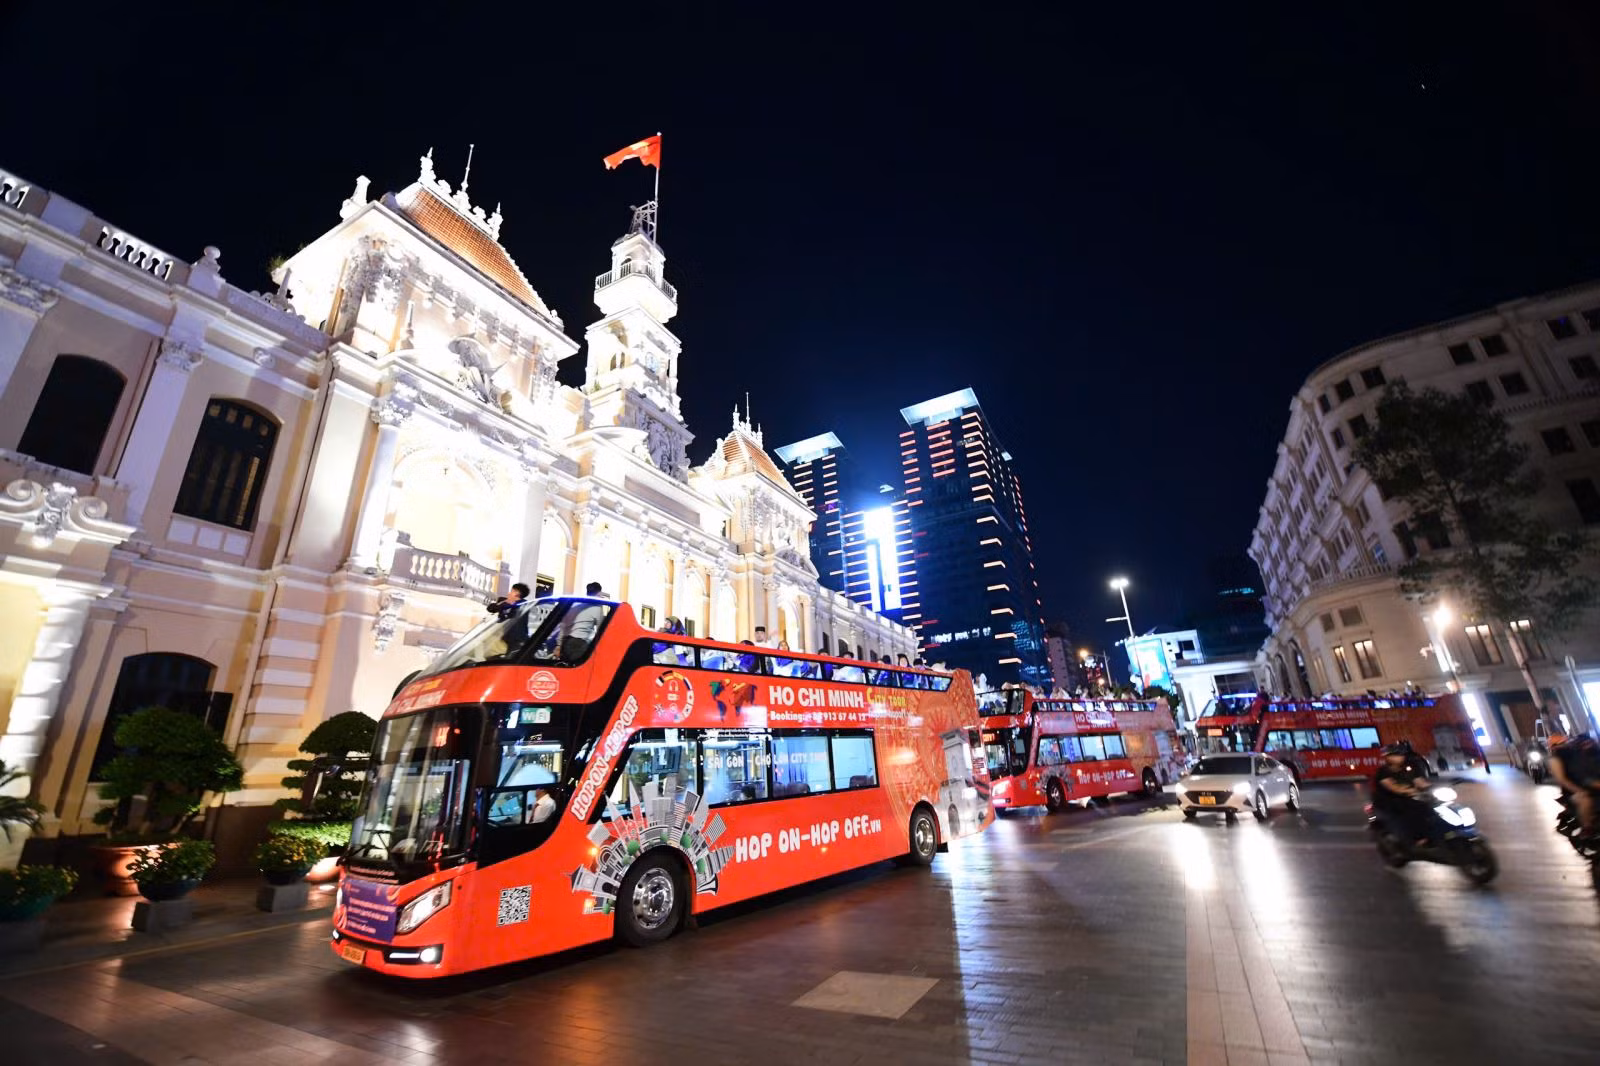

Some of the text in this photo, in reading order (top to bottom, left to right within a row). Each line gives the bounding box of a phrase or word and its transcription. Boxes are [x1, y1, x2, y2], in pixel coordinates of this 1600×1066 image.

[769, 685, 795, 706] HO
[797, 687, 826, 707] CHI
[827, 689, 865, 709] MINH
[770, 710, 805, 723] Booking:
[735, 832, 773, 864] HOP
[778, 820, 840, 854] ON-HOP
